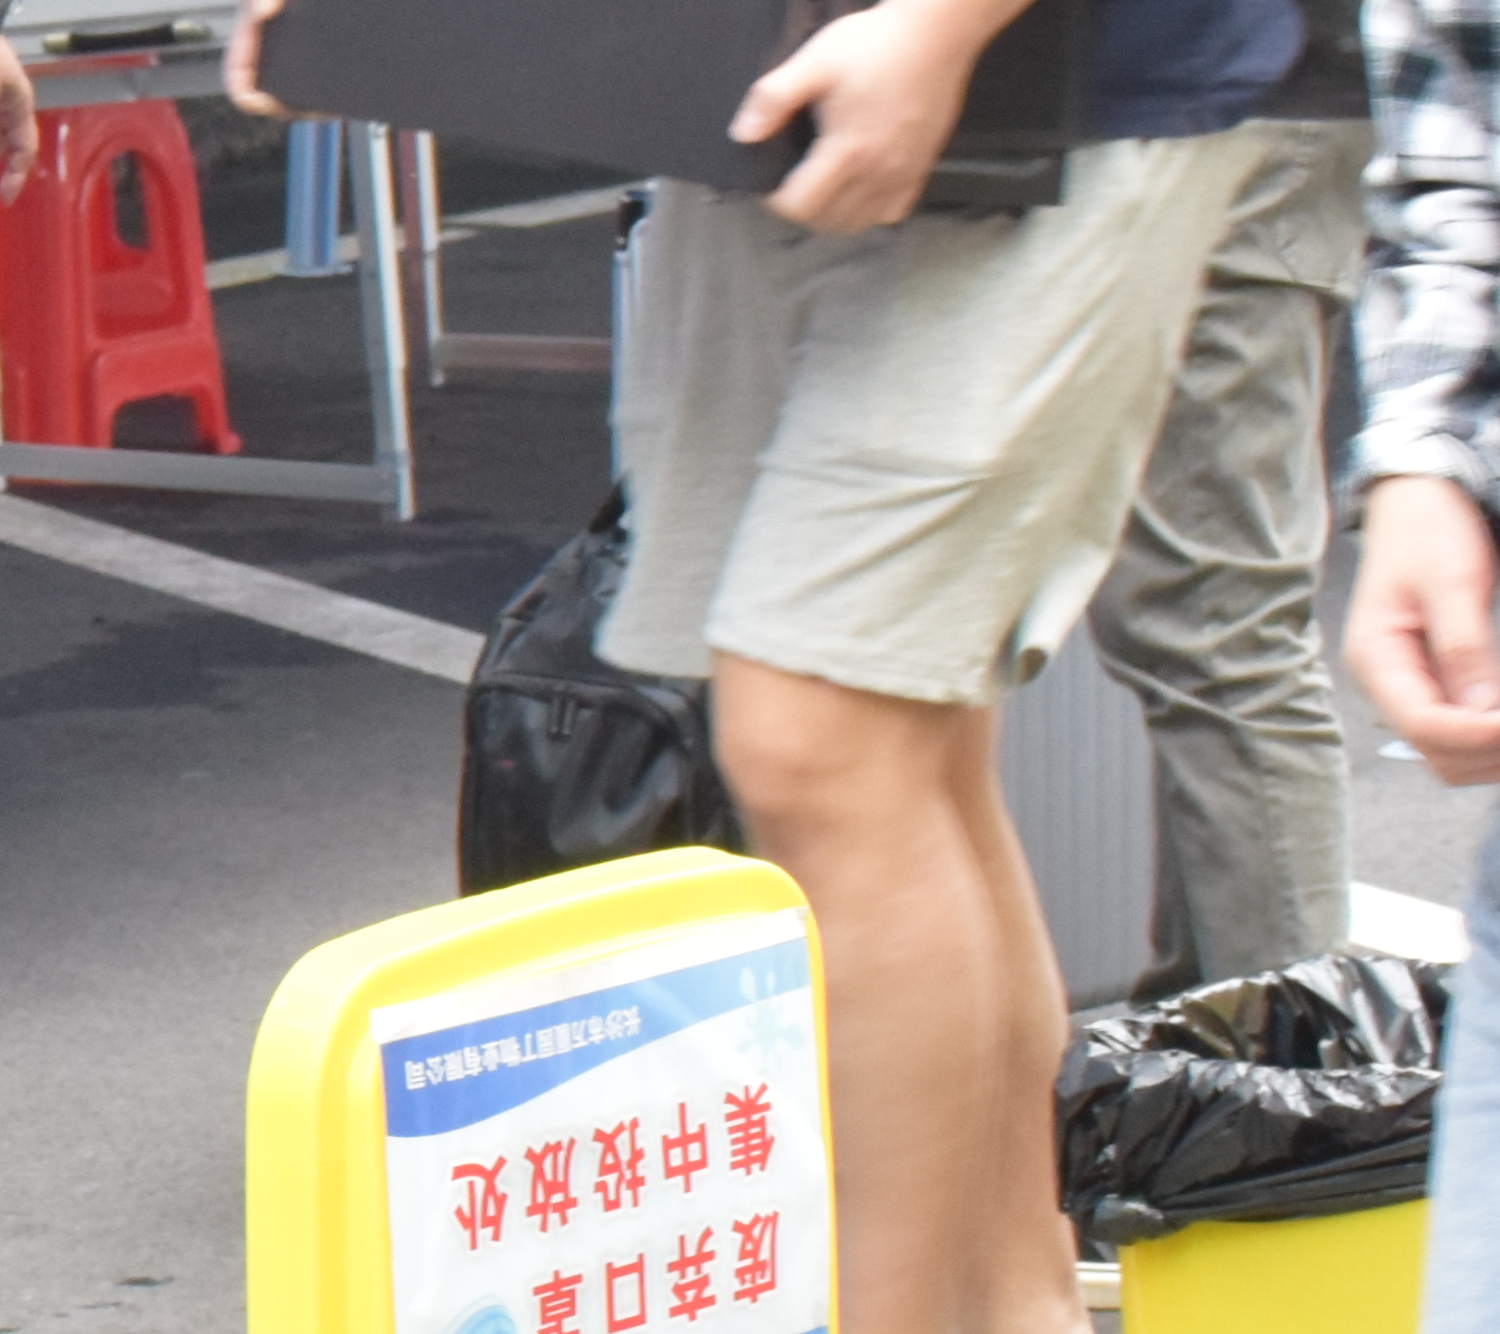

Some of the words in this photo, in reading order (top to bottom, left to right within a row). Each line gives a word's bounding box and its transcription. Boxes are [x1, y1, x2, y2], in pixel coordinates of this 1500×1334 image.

[450, 1082, 774, 1251] 集中投放处
